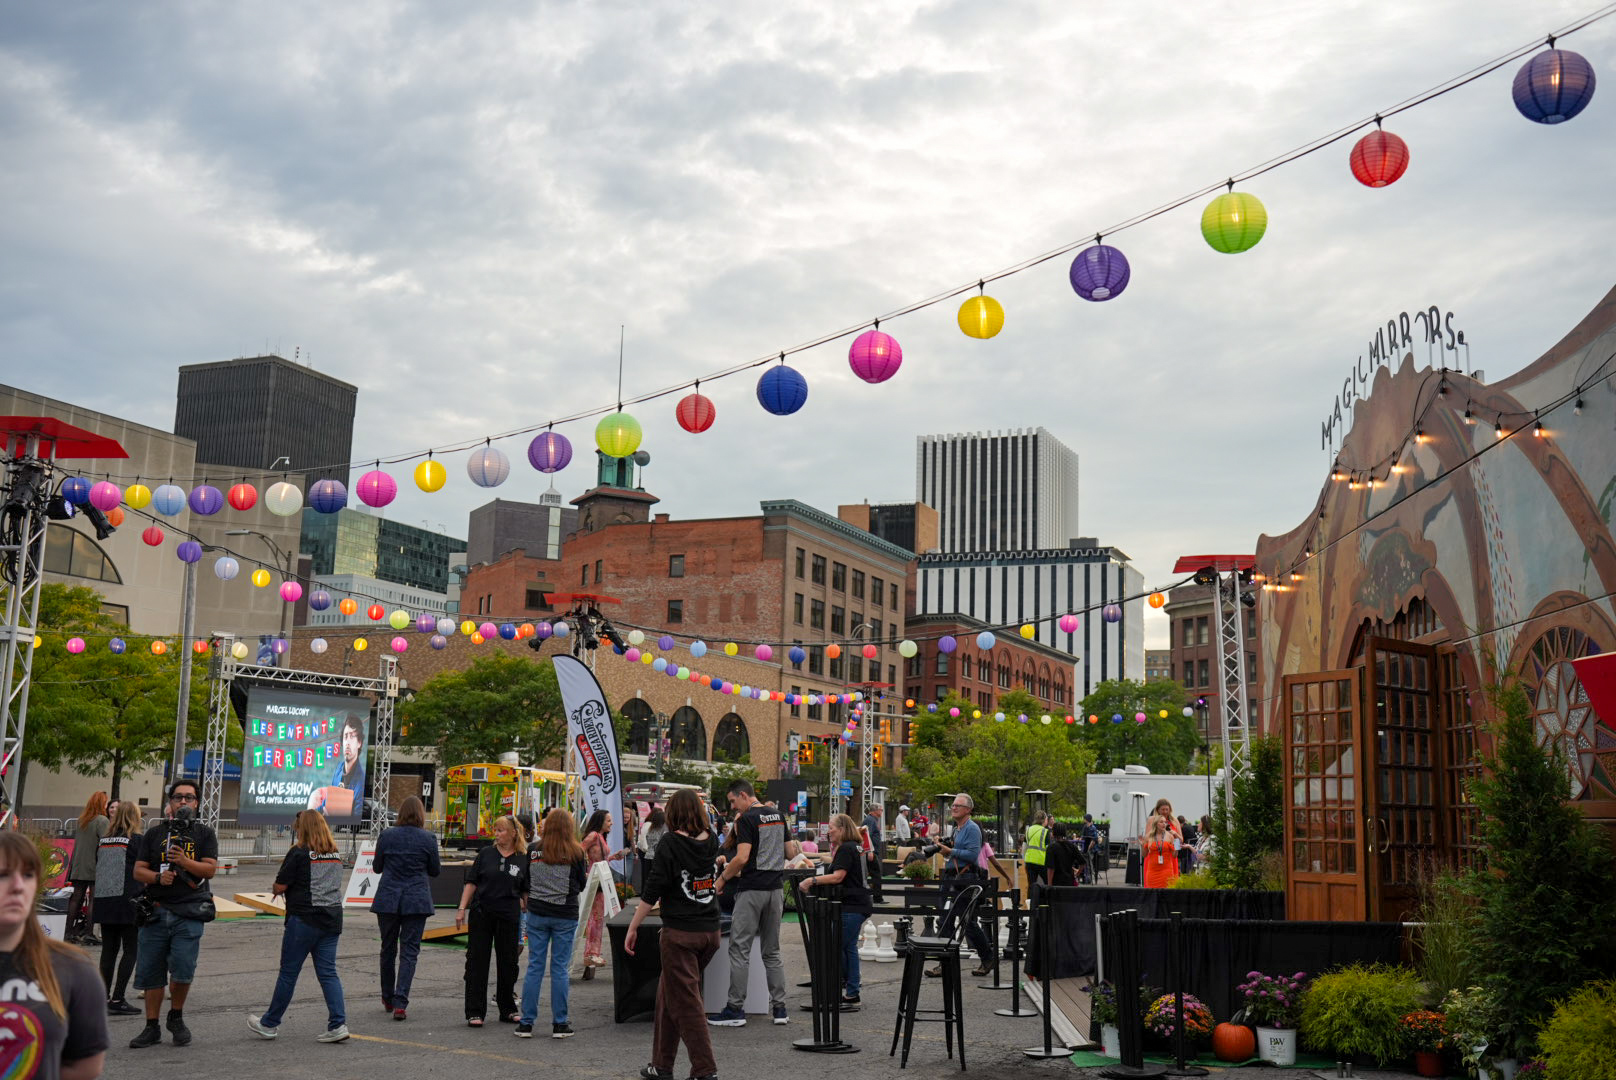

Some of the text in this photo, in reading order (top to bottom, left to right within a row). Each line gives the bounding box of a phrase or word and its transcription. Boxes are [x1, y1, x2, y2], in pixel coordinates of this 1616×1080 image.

[1321, 355, 1368, 451] MAGIC
[266, 705, 289, 715] MARCEL
[253, 718, 335, 739] LES ENFANTS
[255, 745, 340, 768] TERRIBLES
[249, 781, 256, 794] A
[255, 796, 308, 805] FOR AWFUL CHILDREN
